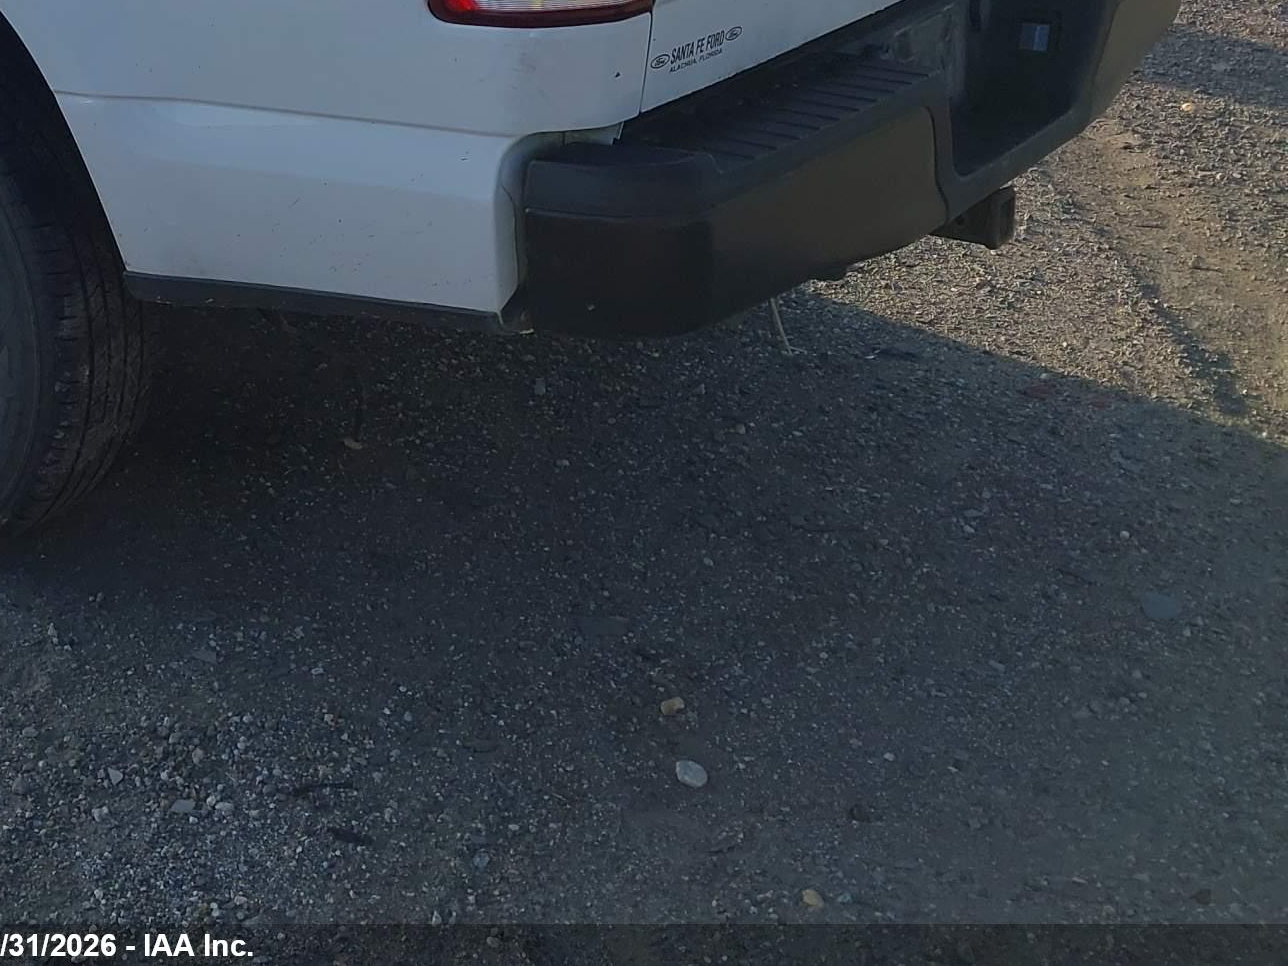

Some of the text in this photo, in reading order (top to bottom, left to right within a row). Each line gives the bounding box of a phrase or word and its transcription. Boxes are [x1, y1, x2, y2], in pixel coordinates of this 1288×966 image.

[671, 41, 694, 64] SANTA
[695, 37, 706, 54] FE
[706, 30, 725, 51] FORD
